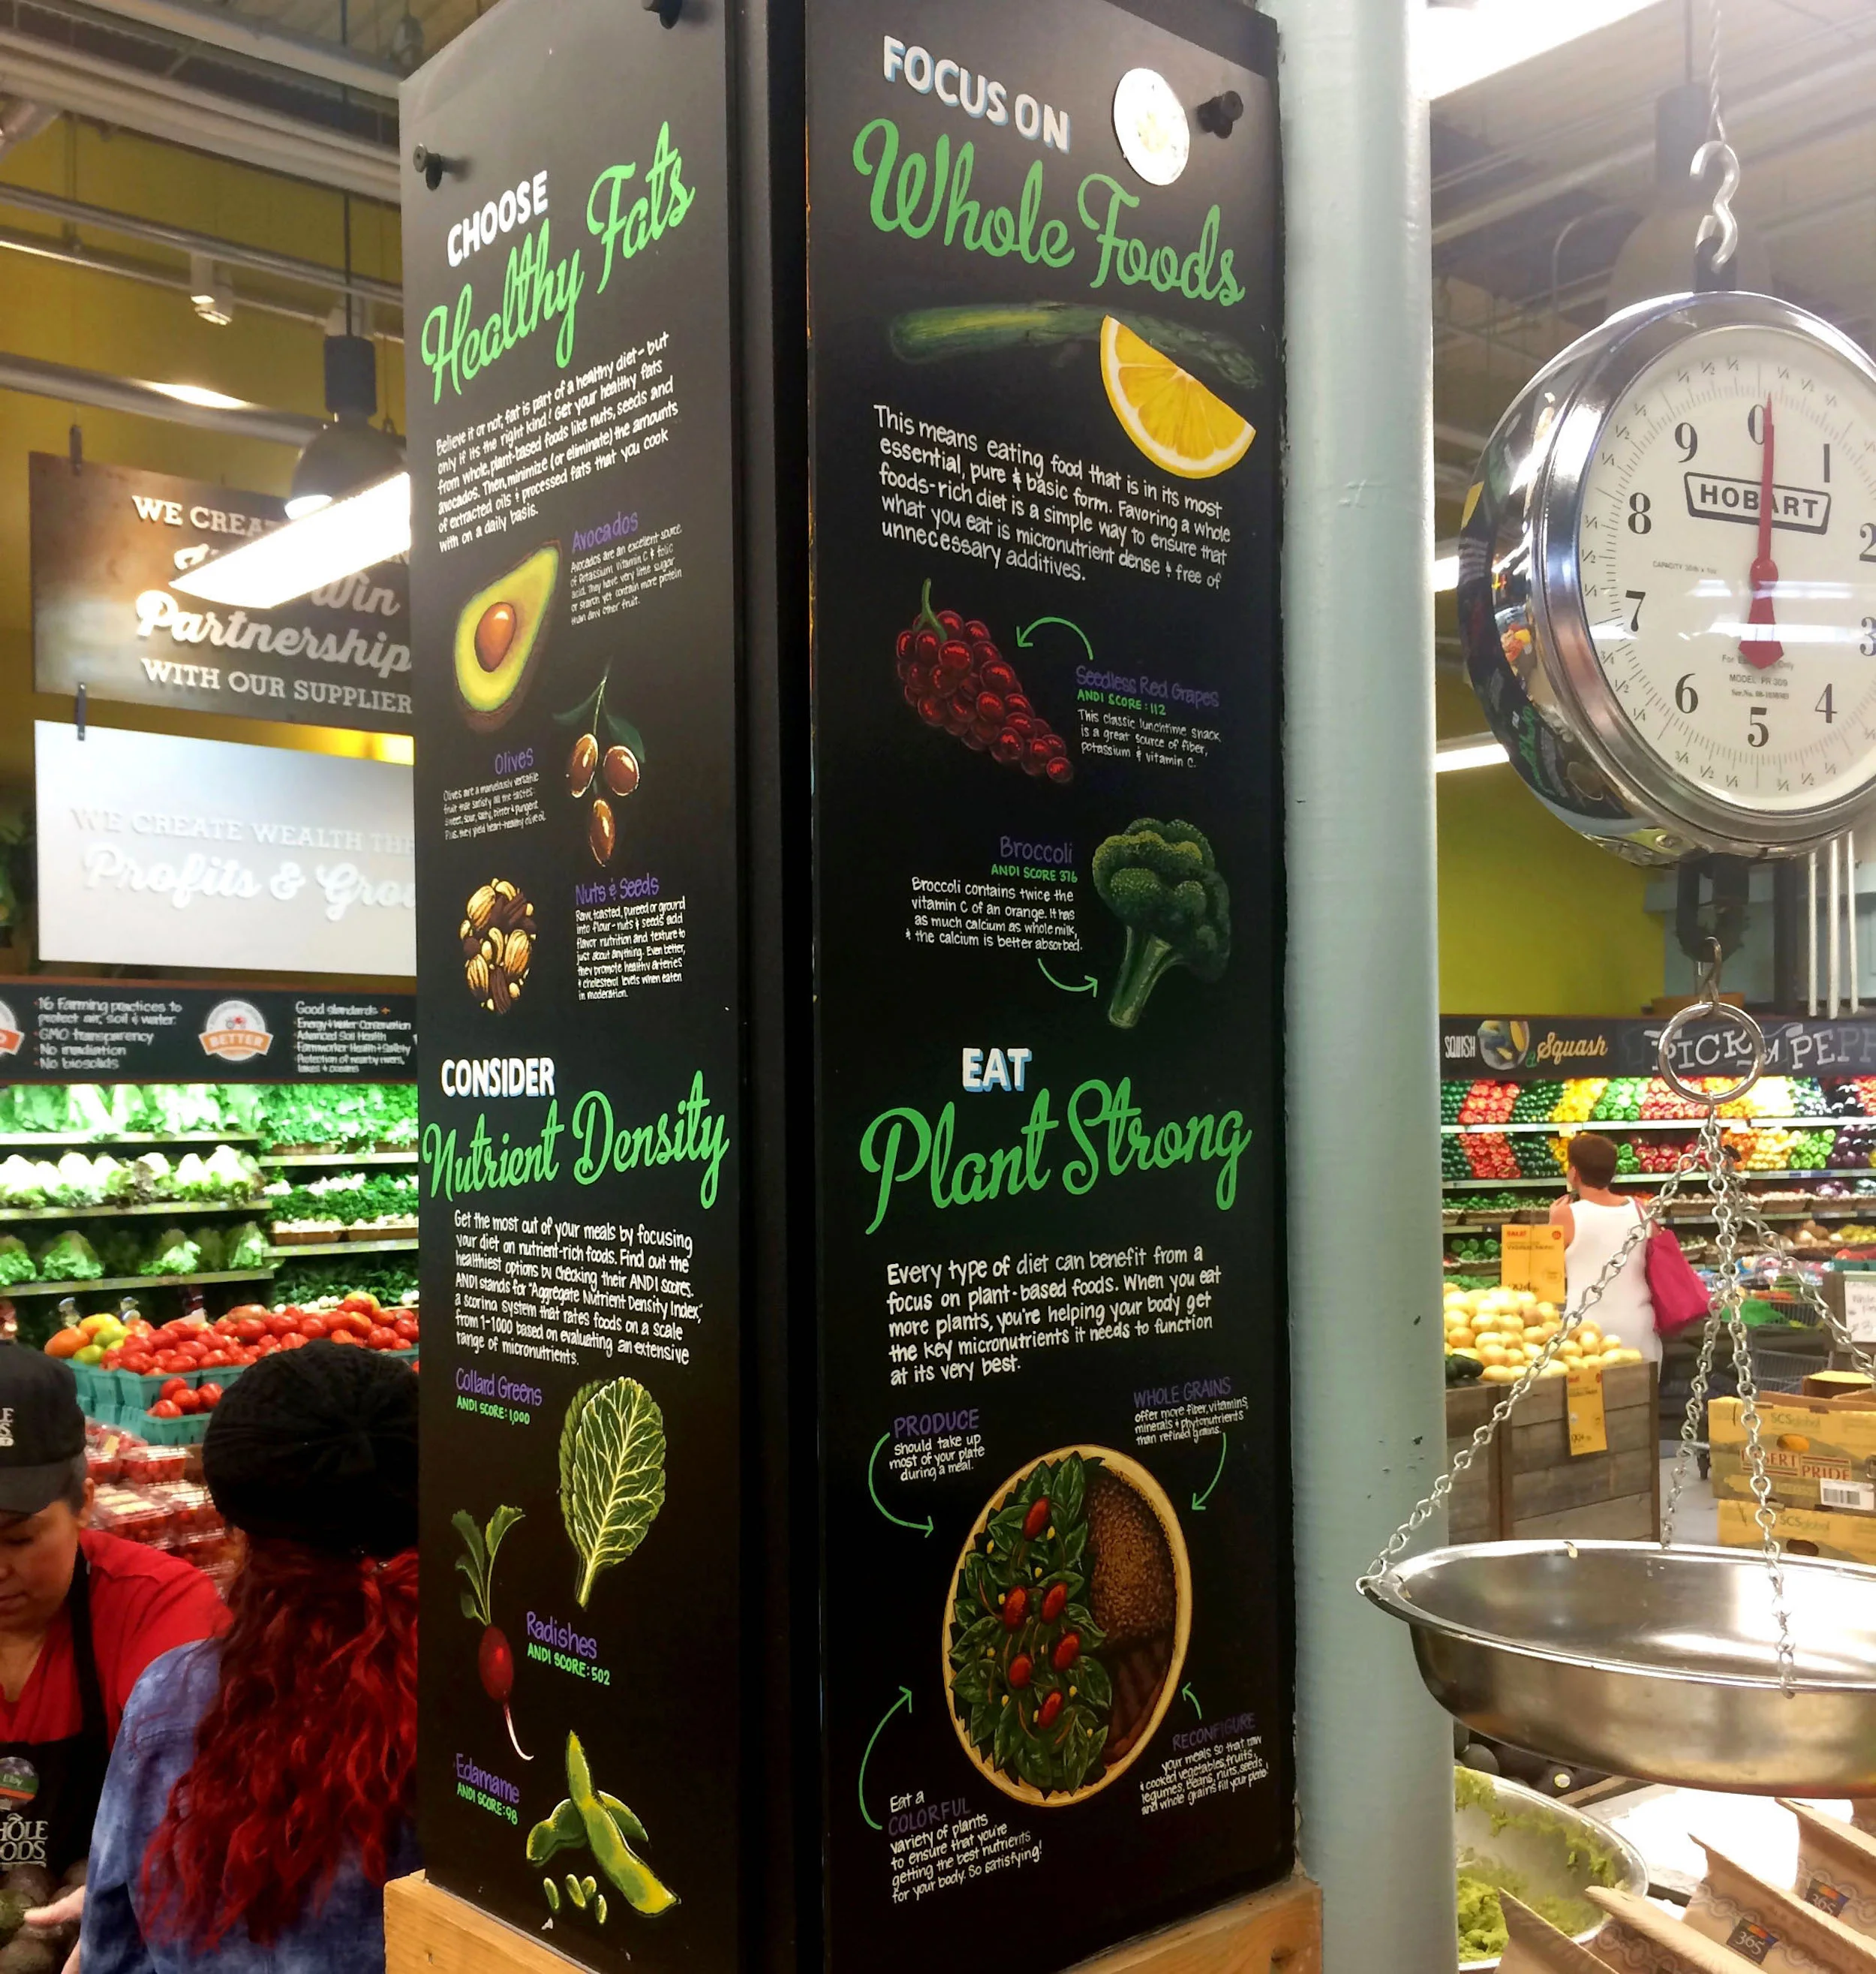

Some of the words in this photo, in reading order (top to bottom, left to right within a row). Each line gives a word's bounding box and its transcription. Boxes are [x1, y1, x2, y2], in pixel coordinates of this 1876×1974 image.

[882, 35, 1009, 127] FOCUS
[1015, 94, 1070, 155] ON
[447, 170, 549, 266] CHOOSE
[852, 118, 1075, 268] Whole
[1078, 173, 1245, 307] Foods
[421, 218, 584, 404] Healthy
[587, 122, 696, 293] Fats
[436, 432, 466, 456] Believe
[467, 428, 474, 441] it
[477, 424, 486, 437] or
[486, 414, 504, 432] not,
[505, 405, 520, 426] fat
[522, 399, 531, 417] is
[533, 390, 552, 413] part
[555, 380, 565, 400] of
[567, 381, 574, 395] a
[576, 361, 613, 390] healthy
[647, 331, 669, 356] but
[873, 403, 915, 436] This
[919, 420, 977, 452] means
[987, 438, 1043, 478] eating
[1051, 453, 1083, 481] food
[1089, 464, 1121, 491] that
[1126, 475, 1140, 495] is
[1144, 480, 1157, 501] in
[1162, 485, 1179, 508] its
[1185, 489, 1222, 519] most
[1674, 422, 1698, 463] 9
[1823, 444, 1830, 483] 1
[131, 495, 183, 526] WE
[1627, 492, 1651, 534] 8
[572, 511, 639, 553] Avocados
[1859, 522, 1876, 563] 2
[1625, 589, 1646, 632] 7
[135, 589, 413, 678] Partnership
[140, 657, 221, 690] WITH
[228, 671, 285, 698] OUR
[293, 679, 413, 714] SUPPLIER
[1076, 665, 1136, 694] Seedless
[1139, 676, 1168, 699] Red
[1171, 683, 1219, 709] Grapes
[1675, 673, 1698, 714] 6
[1729, 674, 1759, 685] MODEL
[1077, 689, 1104, 703] ANDI
[1150, 703, 1166, 716] 112
[1814, 683, 1838, 724] 4
[1747, 706, 1769, 748] 5
[495, 748, 534, 775] Olives
[70, 808, 122, 833] WE
[131, 811, 244, 841] CREATE
[251, 823, 365, 852] WEALTH
[1000, 835, 1072, 864] Broccoli
[82, 841, 263, 910] Profits
[269, 861, 306, 901] &
[576, 883, 606, 905] Nuts
[609, 878, 617, 901] &
[620, 872, 660, 899] Seeds
[912, 877, 961, 893] Broccoli
[965, 883, 1015, 899] contains
[1020, 886, 1050, 901] twice
[1054, 889, 1073, 901] the
[991, 864, 1020, 876] ANDI
[1024, 867, 1056, 881] SCORE
[1060, 870, 1078, 883] 376
[38, 997, 54, 1010] 16
[58, 998, 108, 1013] Farming
[110, 1001, 166, 1013] practices
[170, 1001, 182, 1013] to
[38, 1013, 79, 1027] protect
[106, 1013, 128, 1025] soil
[296, 1001, 324, 1015] Good
[326, 1003, 378, 1016] standards
[39, 1028, 69, 1041] GMO
[73, 1029, 154, 1046] transparency
[40, 1043, 57, 1055] No
[62, 1044, 126, 1055] irradiation
[209, 1034, 263, 1047] BETTER
[1445, 1034, 1475, 1059] SQUISH
[1537, 1031, 1608, 1065] Squash
[40, 1058, 58, 1070] No
[62, 1057, 119, 1070] biosolids
[441, 1057, 555, 1098] CONSIDER
[962, 1047, 1032, 1092] EAT
[422, 1099, 565, 1202] Nutrient
[572, 1070, 729, 1209] Density
[859, 1088, 1059, 1235] Plant
[1062, 1076, 1252, 1210] Strong
[454, 1209, 471, 1228] Get
[474, 1212, 490, 1229] the
[493, 1216, 519, 1233] most
[522, 1217, 538, 1235] out
[541, 1217, 552, 1235] of
[555, 1222, 581, 1244] your
[584, 1223, 615, 1241] meals
[619, 1226, 633, 1246] by
[637, 1224, 693, 1259] focusing
[886, 1262, 942, 1289] Every
[949, 1259, 988, 1286] type
[992, 1254, 1011, 1277] of
[1017, 1252, 1049, 1276] diet
[1055, 1253, 1084, 1272] can
[1090, 1246, 1147, 1270] benefit
[1153, 1245, 1188, 1266] from
[1193, 1246, 1203, 1262] a
[455, 1368, 496, 1398] Collard
[498, 1376, 543, 1407] Greens
[456, 1395, 477, 1413] ANDI
[1134, 1386, 1180, 1408] WHOLE
[1183, 1377, 1231, 1401] GRAINS
[894, 1408, 979, 1439] PRODUCE
[894, 1438, 932, 1456] should
[937, 1435, 962, 1449] take
[967, 1434, 982, 1449] up
[1802, 1467, 1850, 1480] PRIDE
[526, 1610, 597, 1660] Radishes
[527, 1642, 552, 1665] ANDI
[591, 1667, 610, 1685] 502
[1172, 1712, 1256, 1751] RECONFIGURE
[455, 1753, 520, 1804] Edamame
[457, 1781, 475, 1802] ANDI
[888, 1798, 971, 1837] COLORFUL
[890, 1792, 912, 1813] Eat
[915, 1790, 924, 1804] a
[1811, 1894, 1837, 1914] 365
[1735, 1930, 1765, 1954] 365
